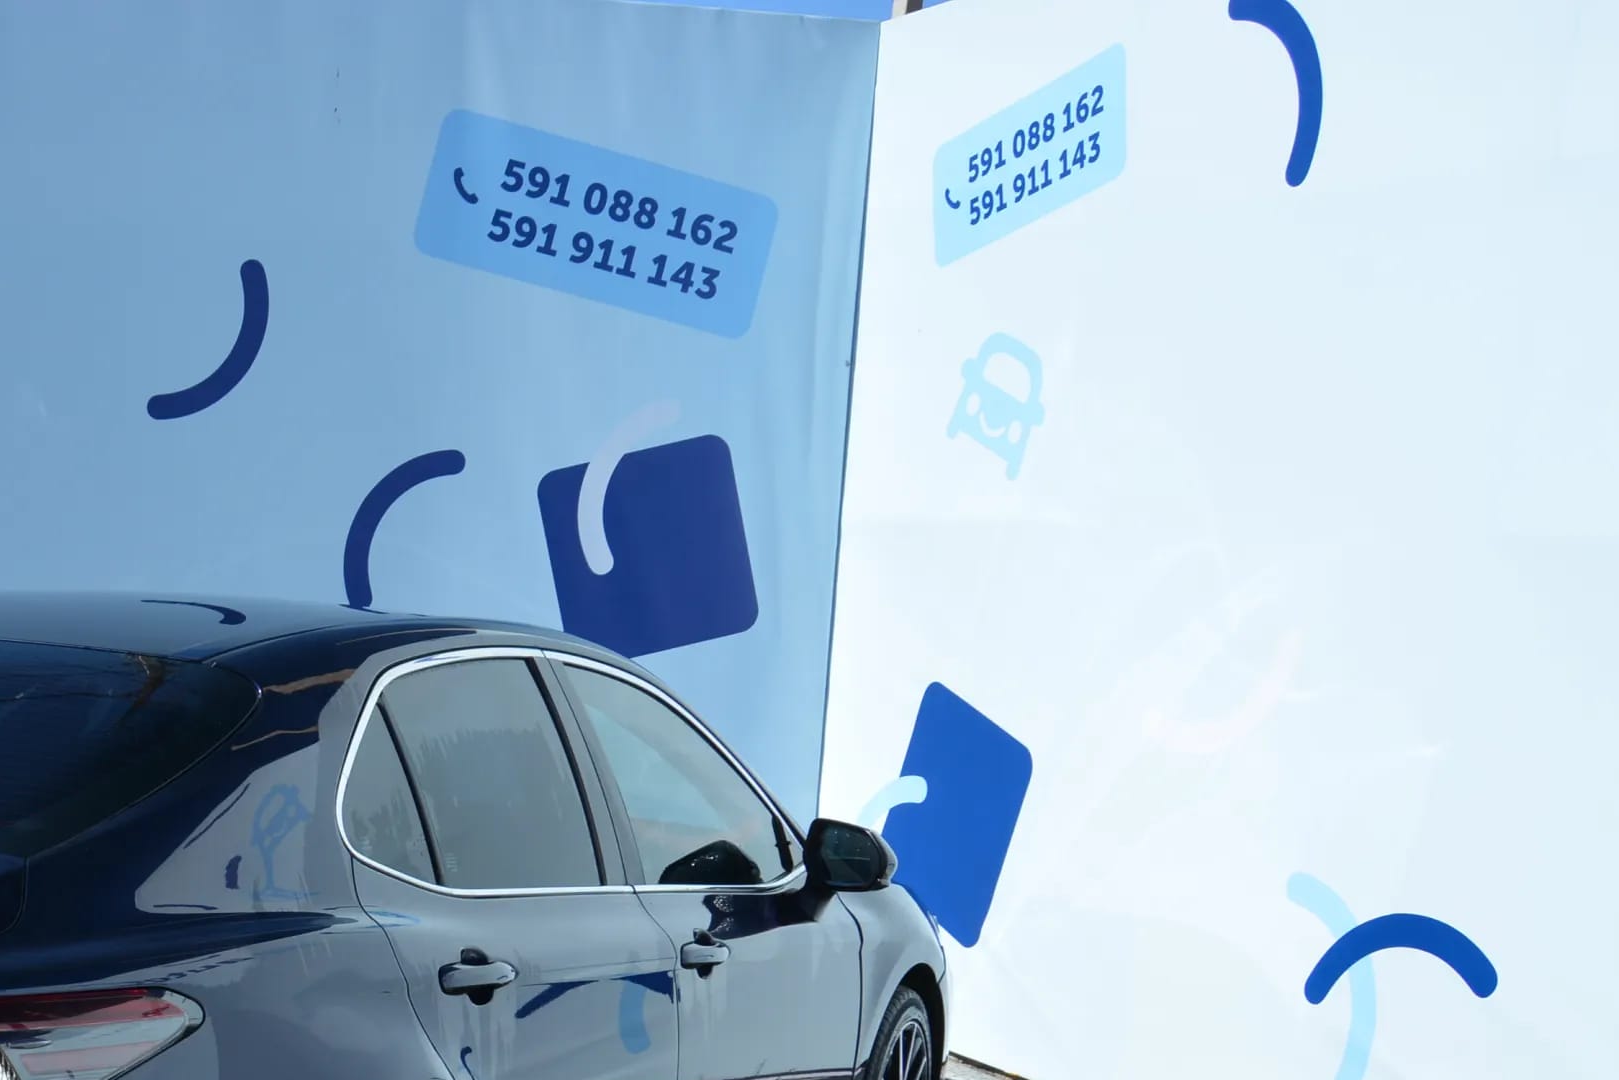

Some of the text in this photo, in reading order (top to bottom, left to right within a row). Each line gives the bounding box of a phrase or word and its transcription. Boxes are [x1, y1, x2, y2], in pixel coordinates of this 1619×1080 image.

[968, 85, 1104, 183] 591 088 162
[969, 131, 1101, 226] 591 911 143
[487, 208, 721, 300] 591 911 143
[500, 159, 738, 255] 591 088 162
